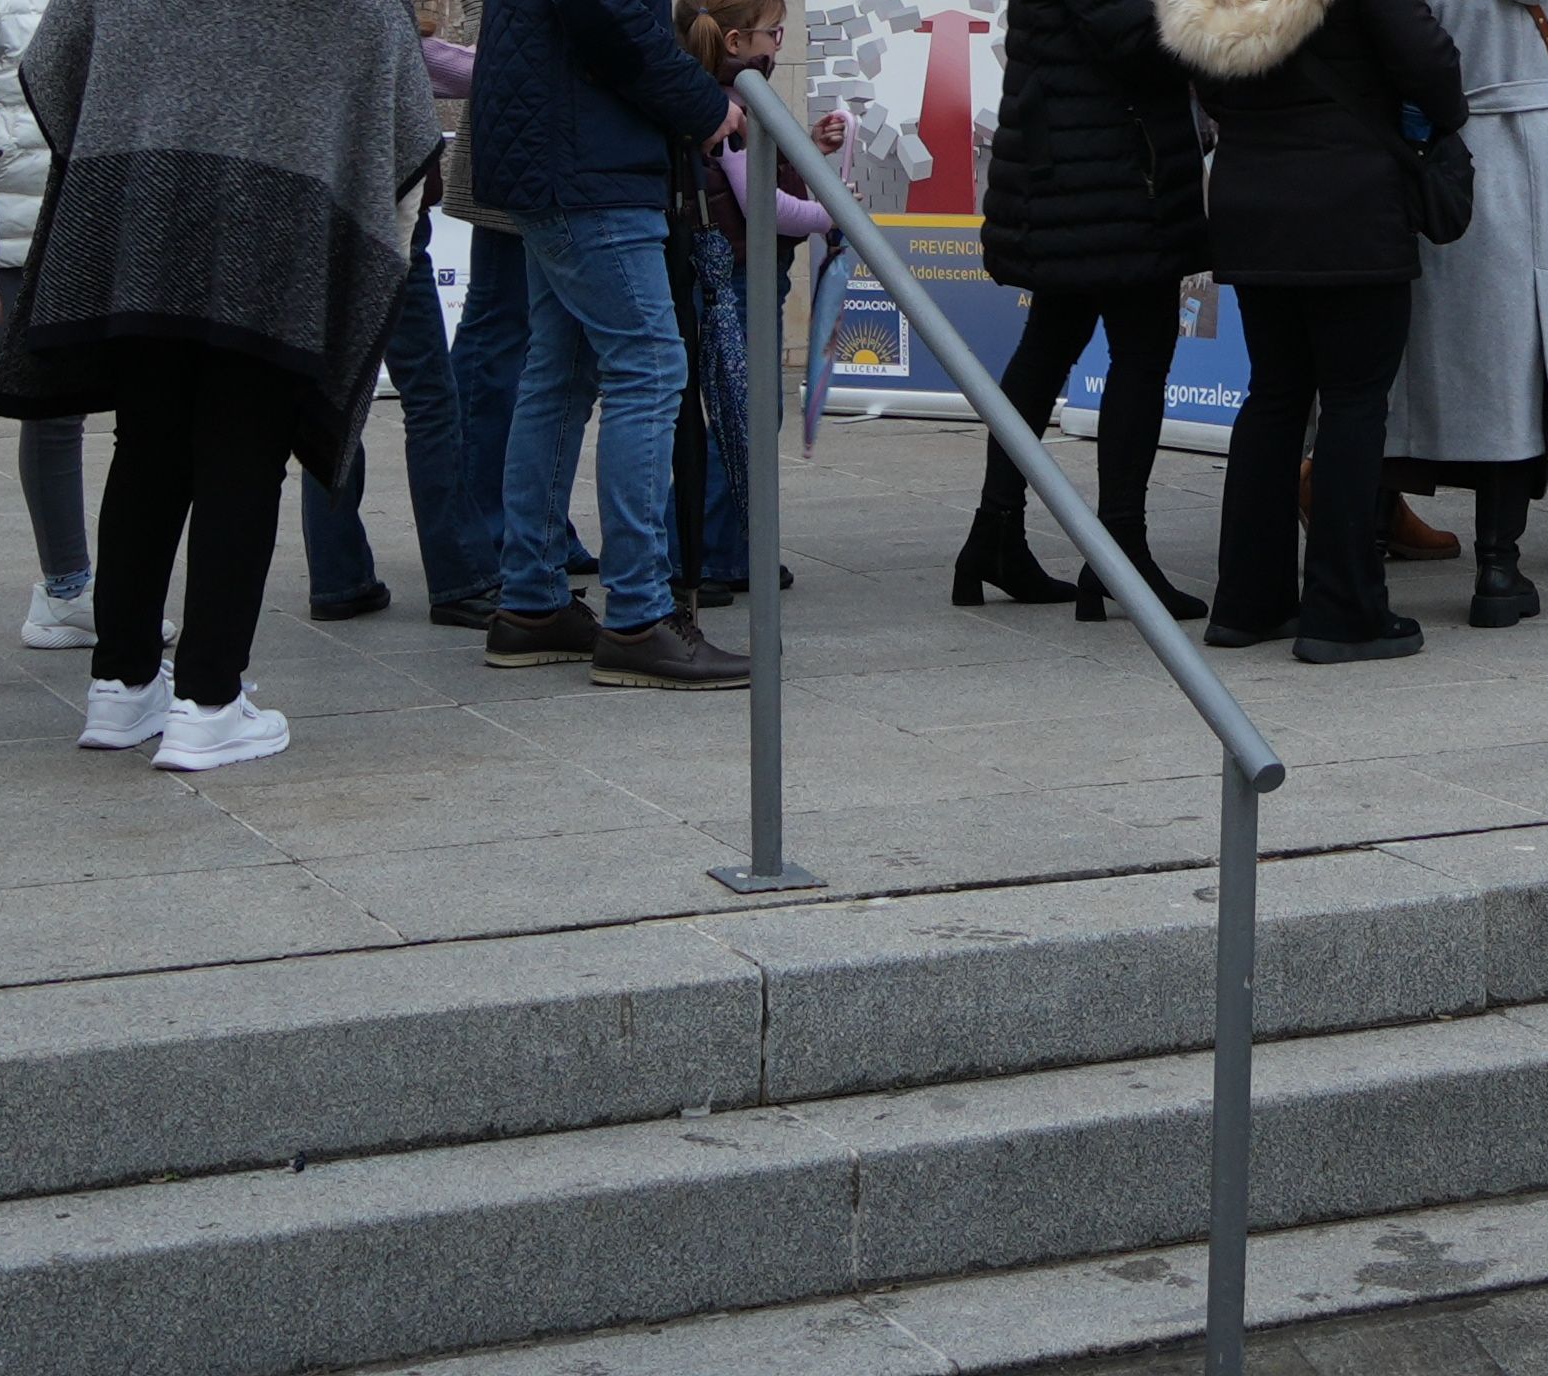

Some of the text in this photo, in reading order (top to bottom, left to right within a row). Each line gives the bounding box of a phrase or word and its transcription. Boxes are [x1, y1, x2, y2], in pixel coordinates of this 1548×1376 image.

[908, 264, 993, 281] Adolescente
[843, 299, 897, 312] SOCIACION
[844, 364, 888, 374] LUCENA
